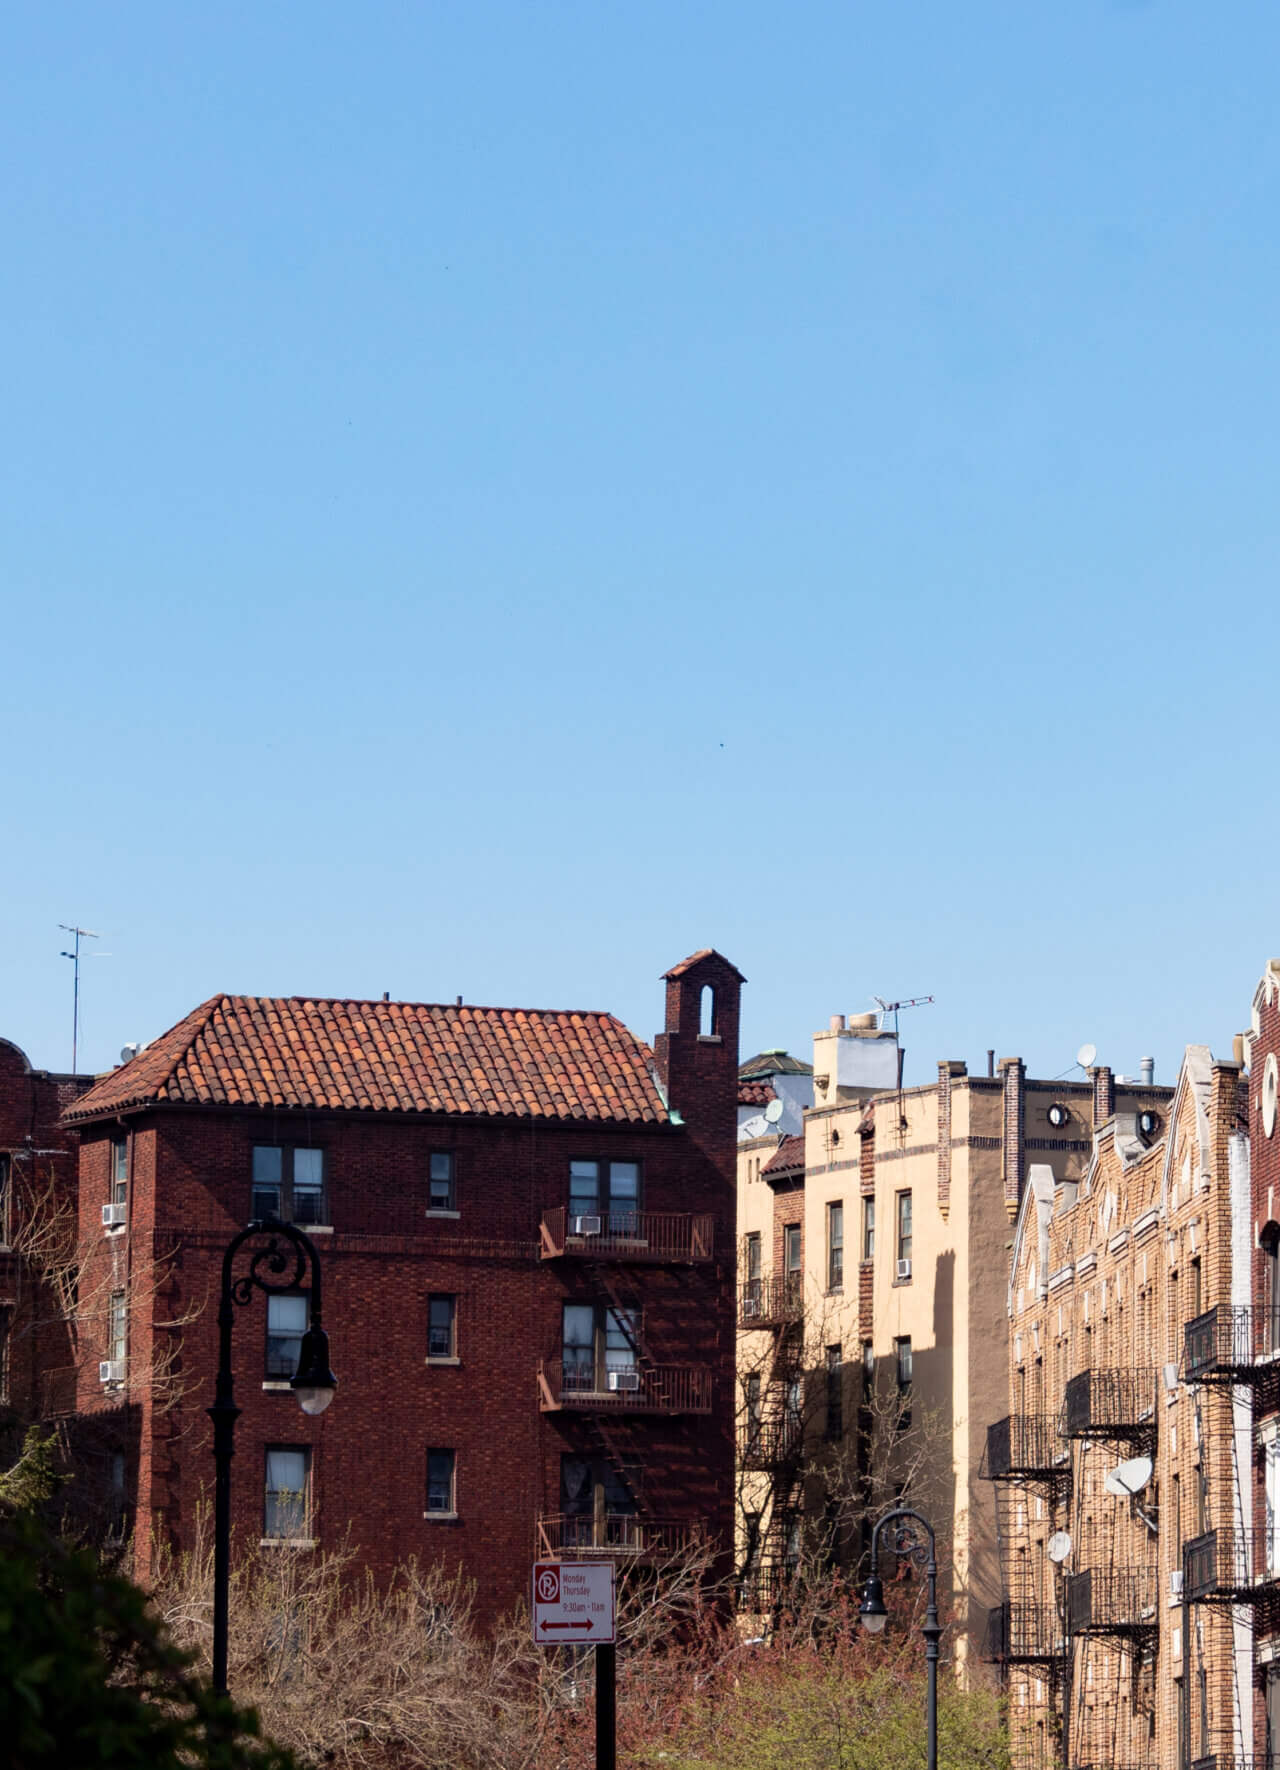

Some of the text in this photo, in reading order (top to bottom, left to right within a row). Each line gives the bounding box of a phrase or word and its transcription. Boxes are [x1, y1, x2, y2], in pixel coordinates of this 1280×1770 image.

[563, 1573, 585, 1584] Monday
[563, 1586, 590, 1597] Thursday
[563, 1602, 585, 1612] 9:30am
[592, 1602, 605, 1612] 11am
